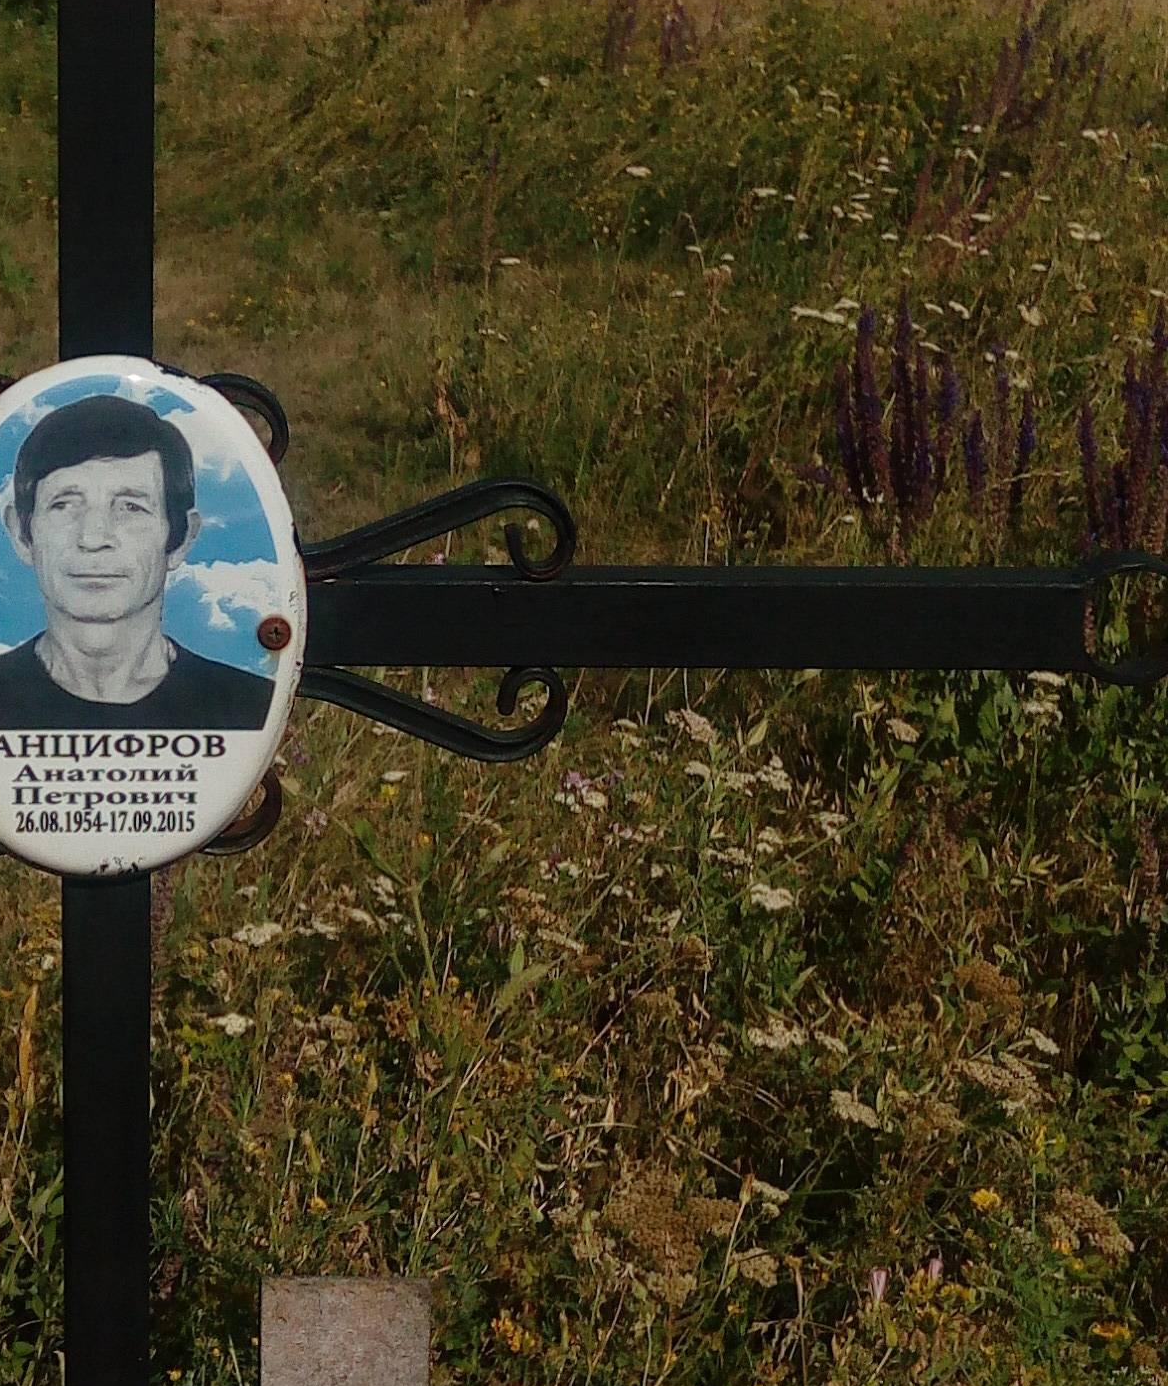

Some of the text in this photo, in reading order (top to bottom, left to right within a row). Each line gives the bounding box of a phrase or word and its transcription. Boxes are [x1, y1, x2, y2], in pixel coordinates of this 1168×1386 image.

[12, 763, 198, 782] Анатолий
[11, 786, 198, 811] Петрович
[15, 810, 196, 833] 26.08.1954-17.09.2015
